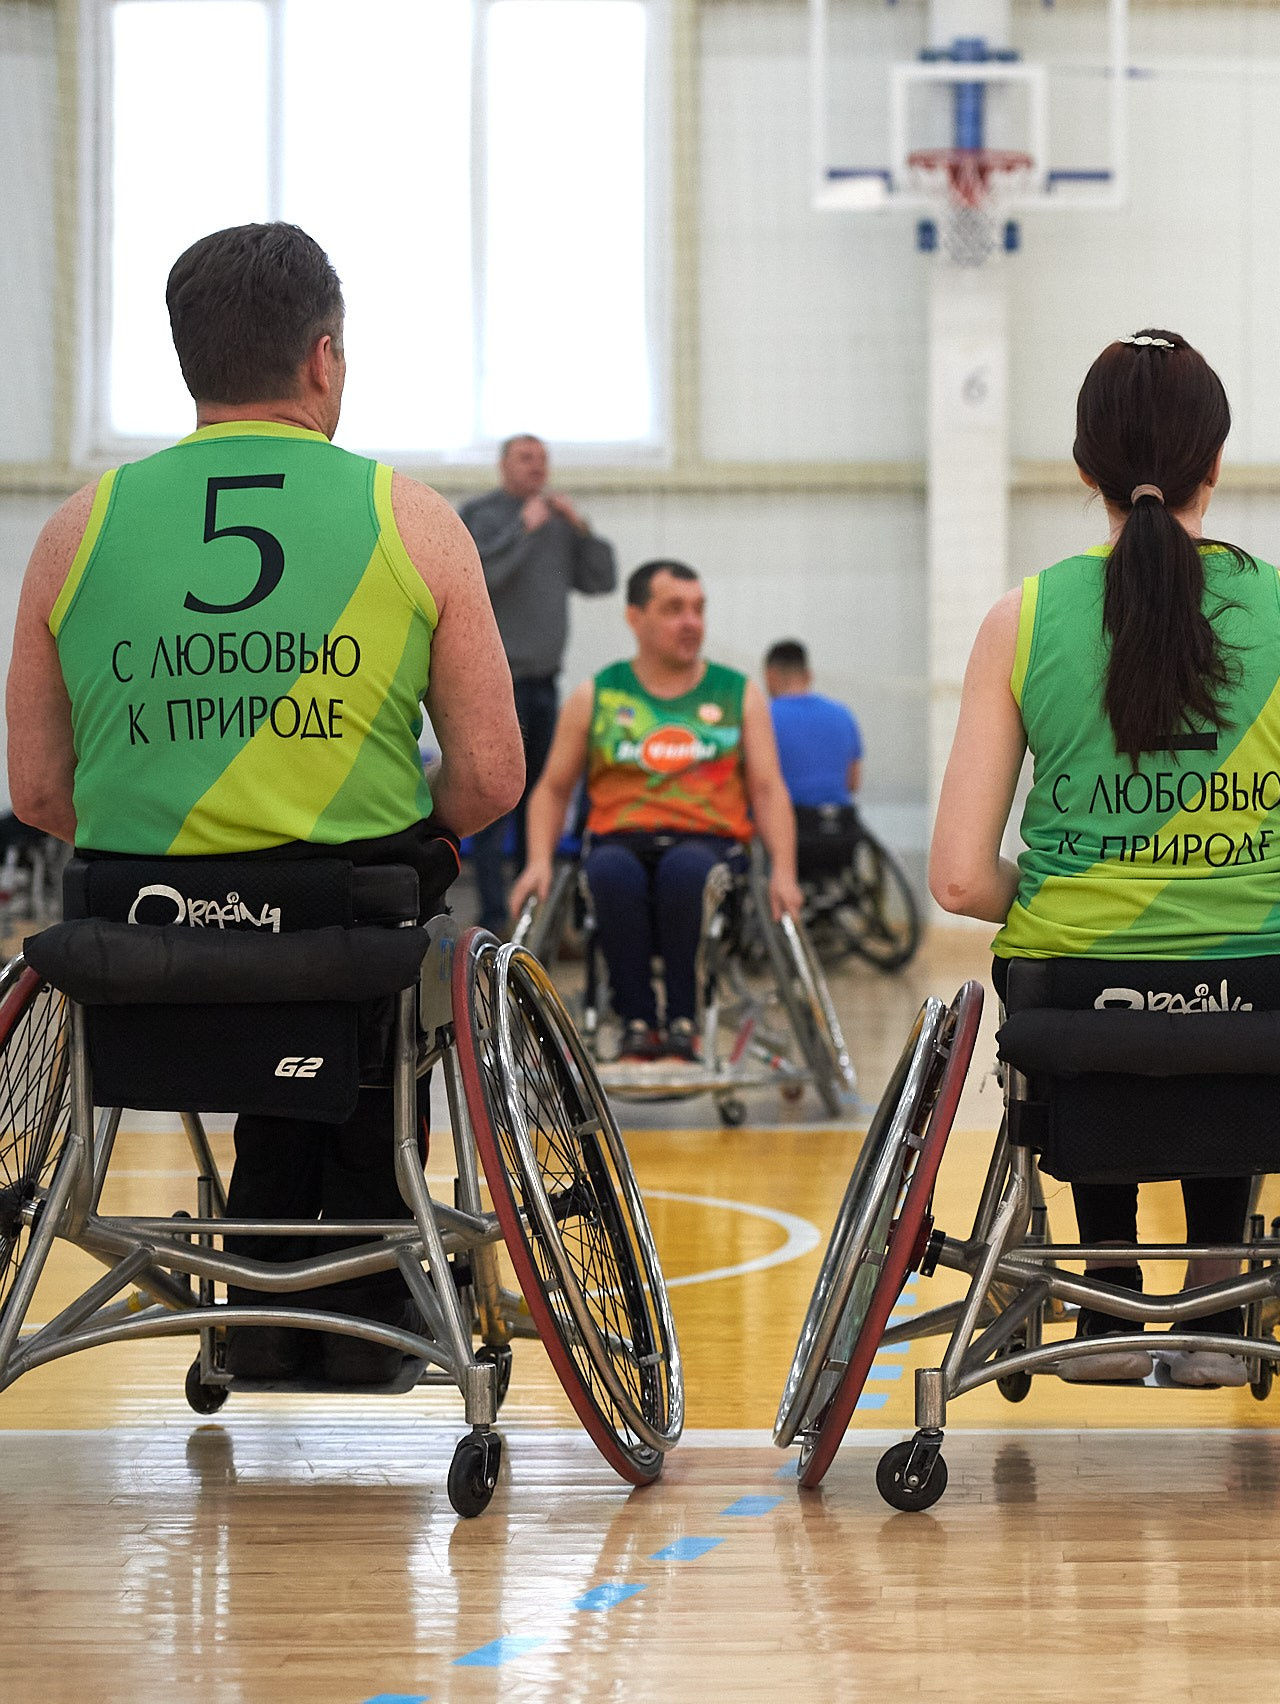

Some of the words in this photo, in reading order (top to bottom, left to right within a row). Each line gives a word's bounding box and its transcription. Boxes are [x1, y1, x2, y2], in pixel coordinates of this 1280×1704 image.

[183, 473, 286, 615] 5
[111, 639, 134, 683] С
[150, 630, 362, 680] ЛЮБОВЬЮ
[127, 702, 151, 746] К
[166, 694, 345, 742] ПРИРОДЕ
[1051, 773, 1072, 815] С
[1057, 831, 1083, 856] К
[274, 1056, 324, 1078] G2
